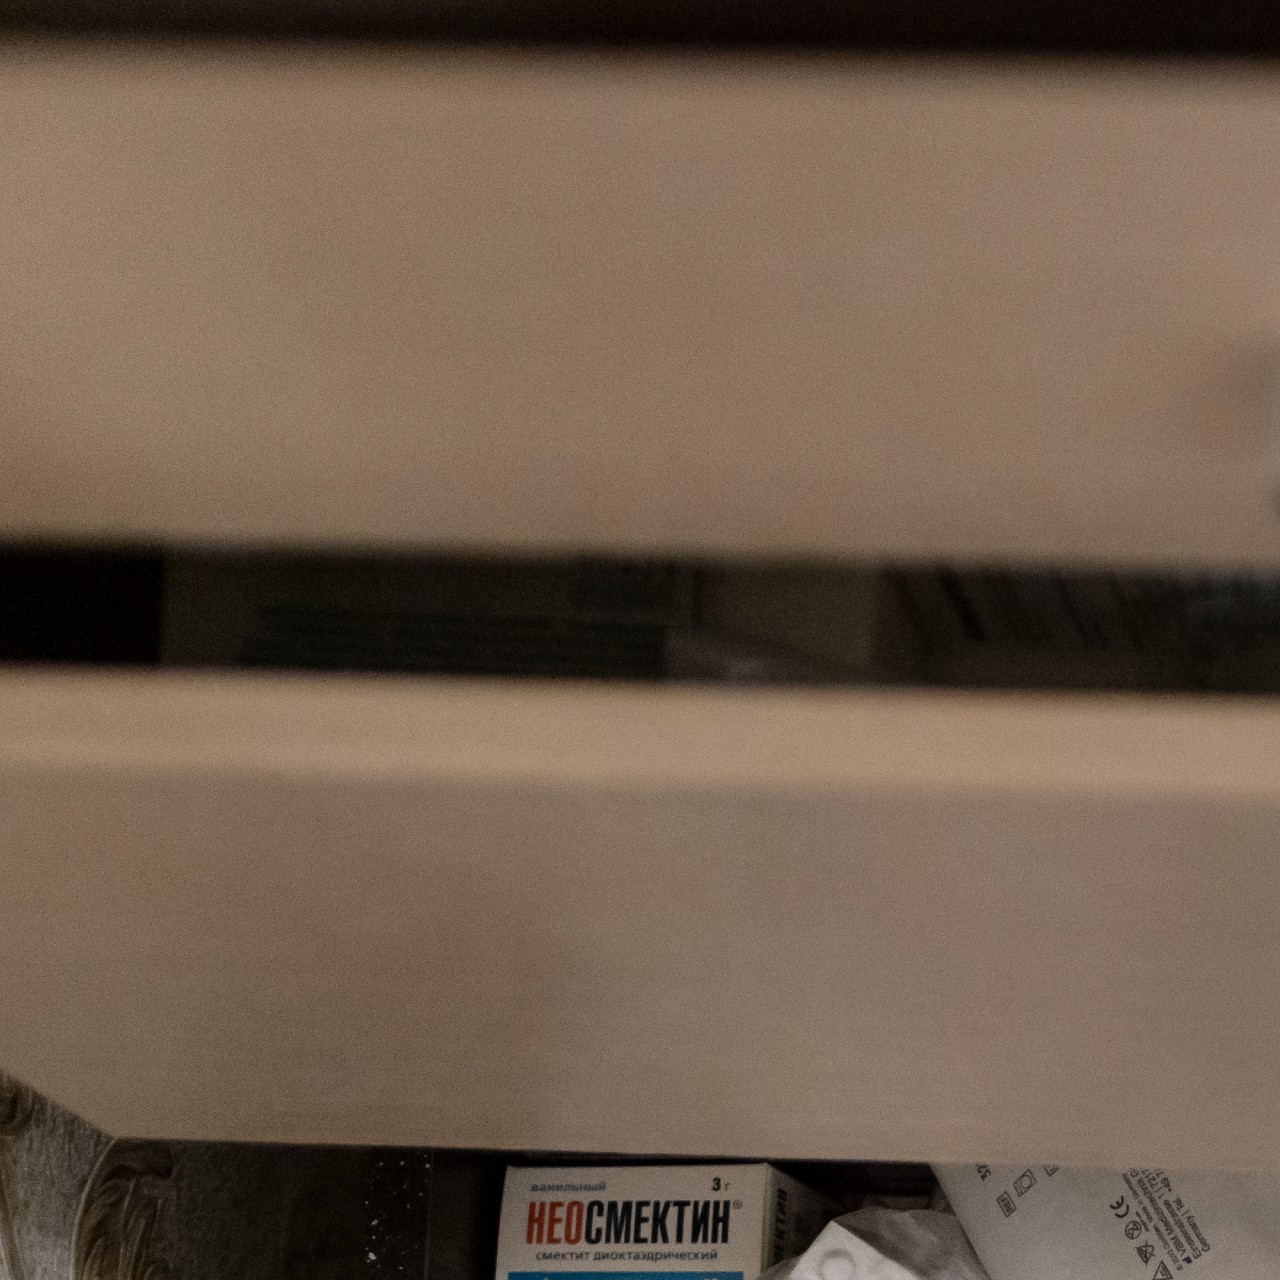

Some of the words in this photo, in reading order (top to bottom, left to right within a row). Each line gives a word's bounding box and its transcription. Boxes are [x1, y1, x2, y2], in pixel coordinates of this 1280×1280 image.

[711, 1177, 721, 1191] 3
[535, 1250, 589, 1261] смектит
[592, 1249, 718, 1261] диоктаэдрический
